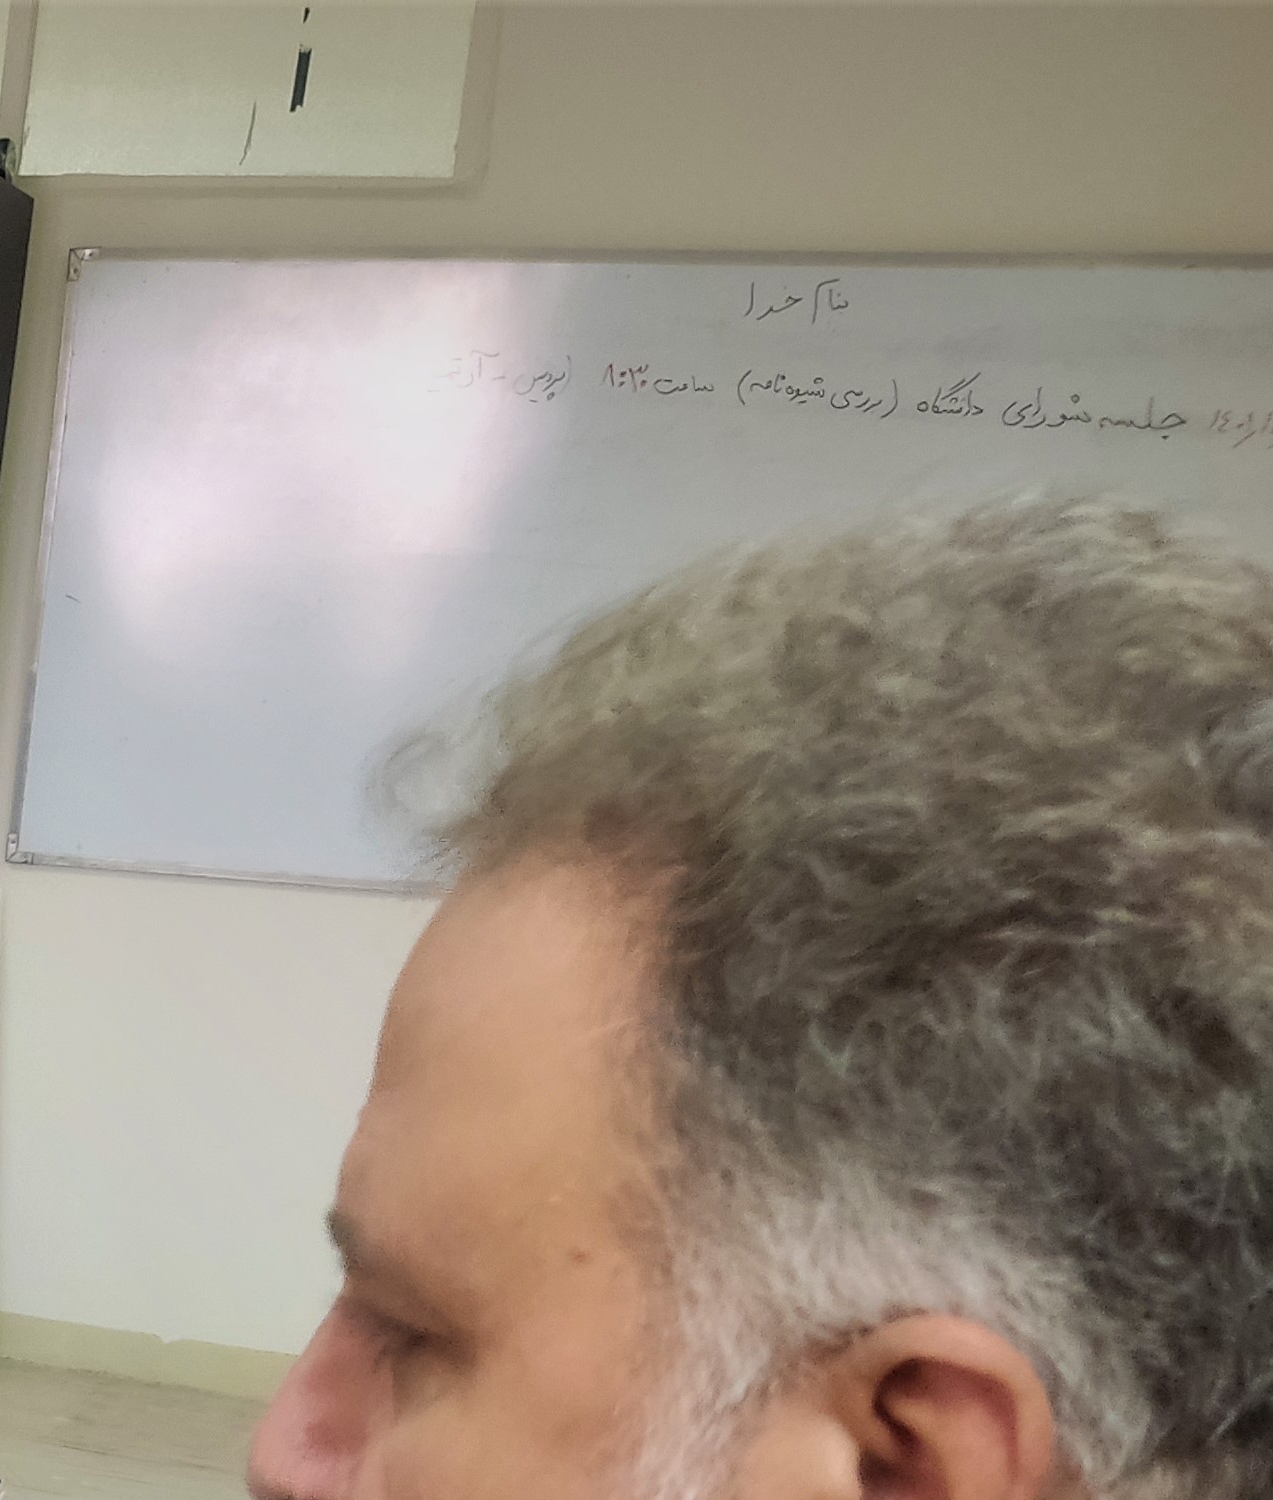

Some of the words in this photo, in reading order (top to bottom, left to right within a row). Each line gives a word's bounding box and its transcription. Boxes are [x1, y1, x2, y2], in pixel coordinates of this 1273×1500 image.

[744, 281, 803, 321] خدا
[654, 375, 715, 395] ساعت
[916, 372, 984, 417] دانشگاه
[1002, 386, 1093, 429] شورای
[1100, 396, 1187, 440] جلسه
